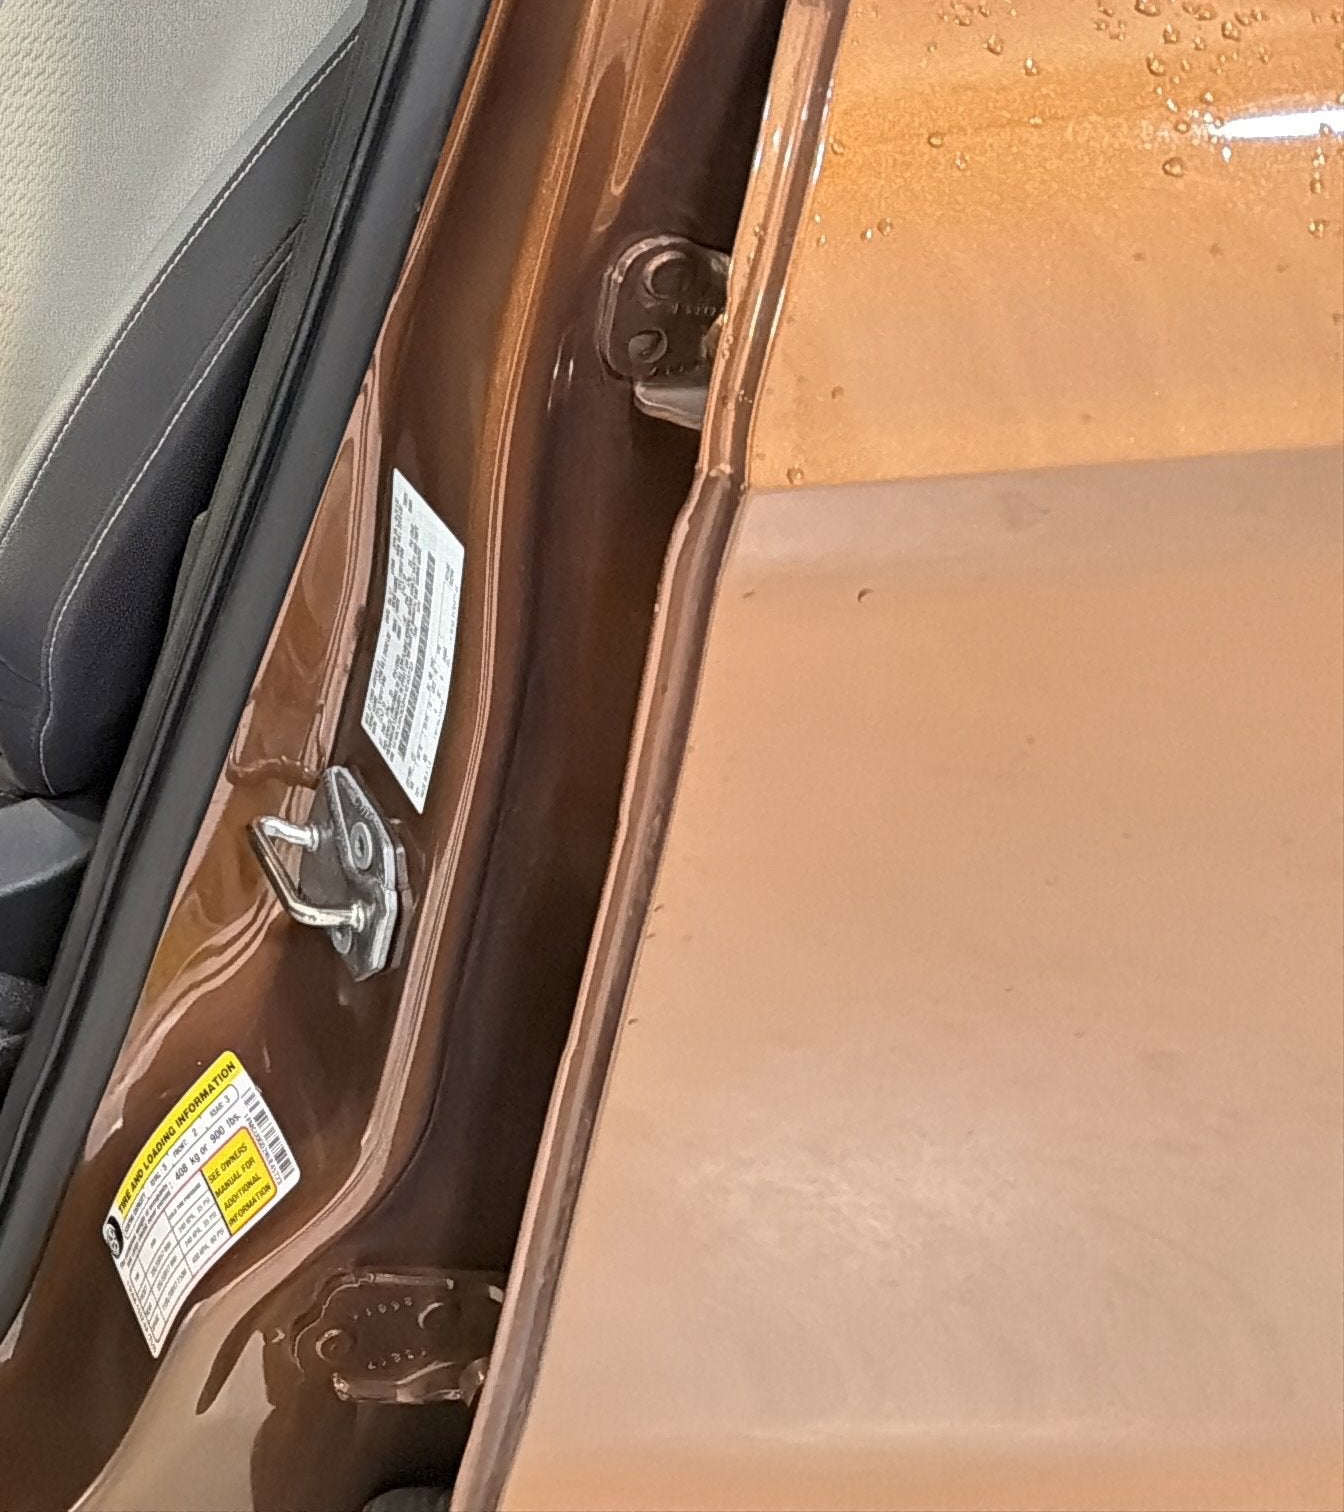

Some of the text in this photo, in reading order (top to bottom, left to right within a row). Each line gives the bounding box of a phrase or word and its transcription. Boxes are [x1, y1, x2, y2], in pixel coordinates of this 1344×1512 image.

[225, 1094, 231, 1104] 3
[118, 1192, 132, 1213] TIRE
[130, 1169, 144, 1190] AND
[143, 1126, 176, 1168] LOADING
[175, 1060, 237, 1127] INFORMATION
[174, 1163, 189, 1181] 408
[189, 1152, 201, 1165] kg
[200, 1144, 209, 1155] or
[209, 1125, 226, 1144] 900
[192, 1128, 198, 1137] 2
[208, 1143, 248, 1184] SEE OWNERS
[215, 1156, 255, 1198] MANUAL FOR
[224, 1173, 262, 1211] ADDITIONAL
[229, 1183, 271, 1227] INFORMATION
